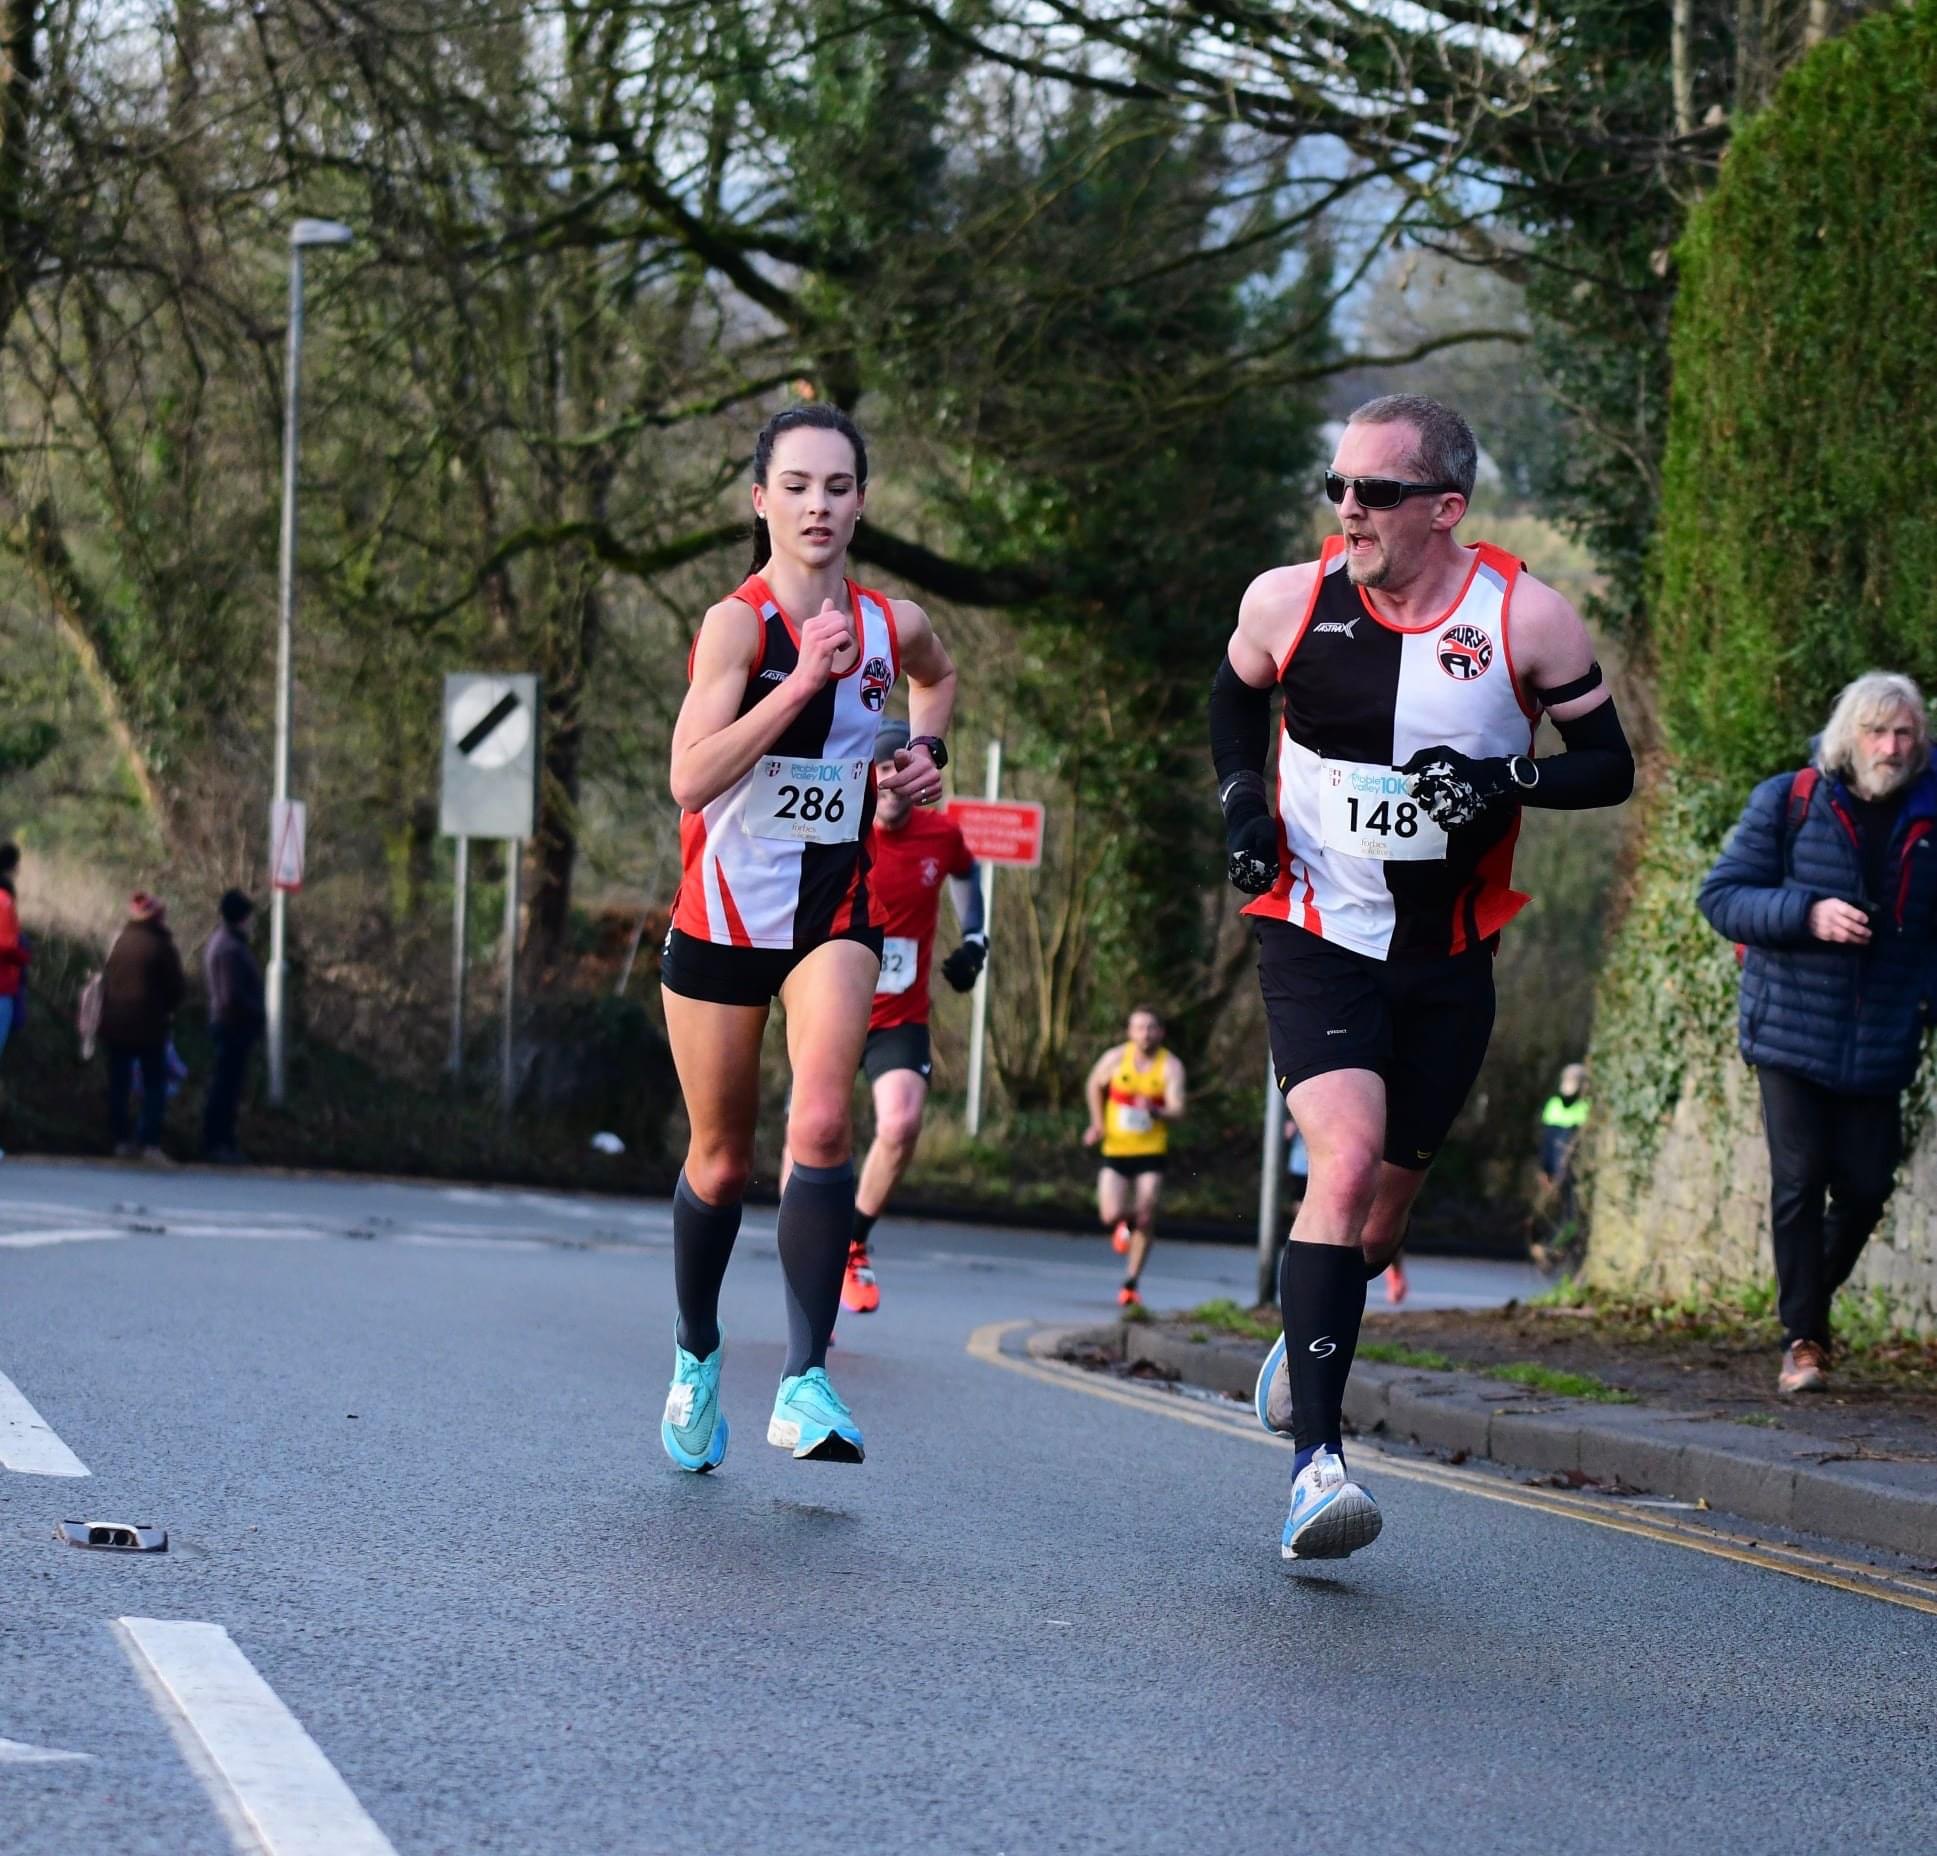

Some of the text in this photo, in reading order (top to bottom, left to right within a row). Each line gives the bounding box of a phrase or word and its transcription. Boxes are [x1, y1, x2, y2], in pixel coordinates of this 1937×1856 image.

[1442, 626, 1486, 649] BURY
[818, 765, 844, 781] 10K
[1381, 776, 1409, 795] 10K
[774, 785, 845, 823] 286
[1347, 797, 1418, 838] 148
